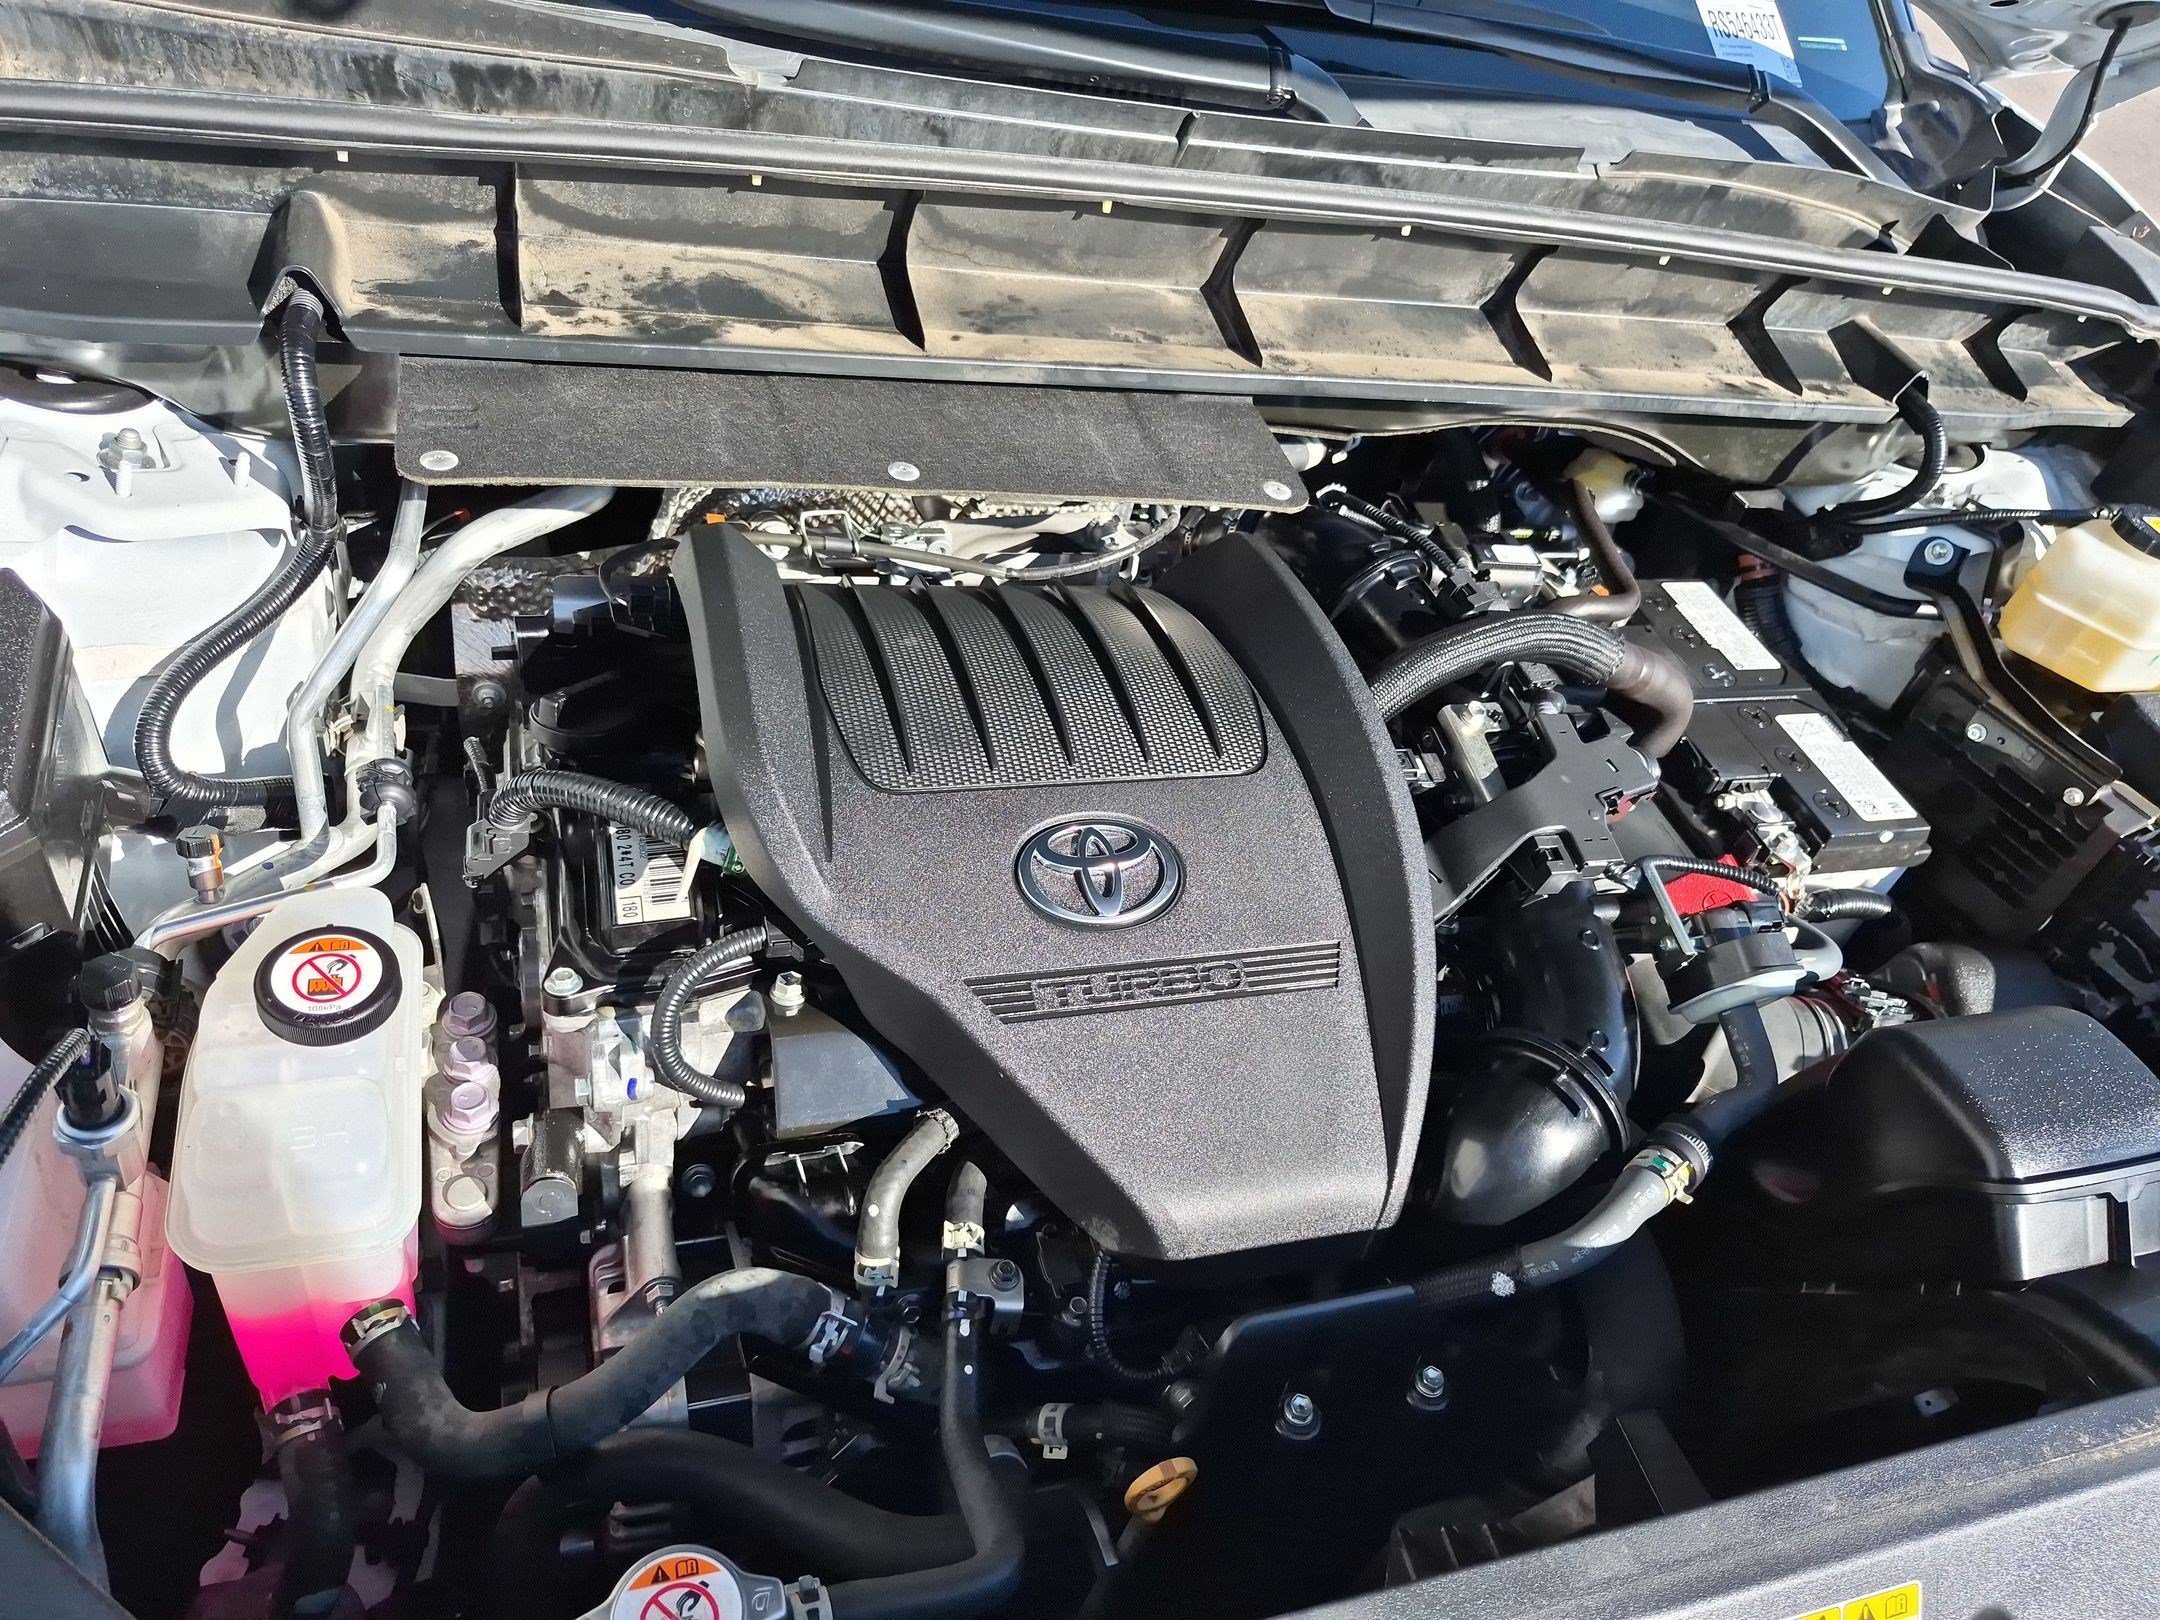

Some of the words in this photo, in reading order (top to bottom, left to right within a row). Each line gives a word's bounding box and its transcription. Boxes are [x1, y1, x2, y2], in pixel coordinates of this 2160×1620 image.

[1707, 10, 1782, 42] RS546433T
[622, 901, 639, 918] 180
[1031, 958, 1249, 1012] TURBO
